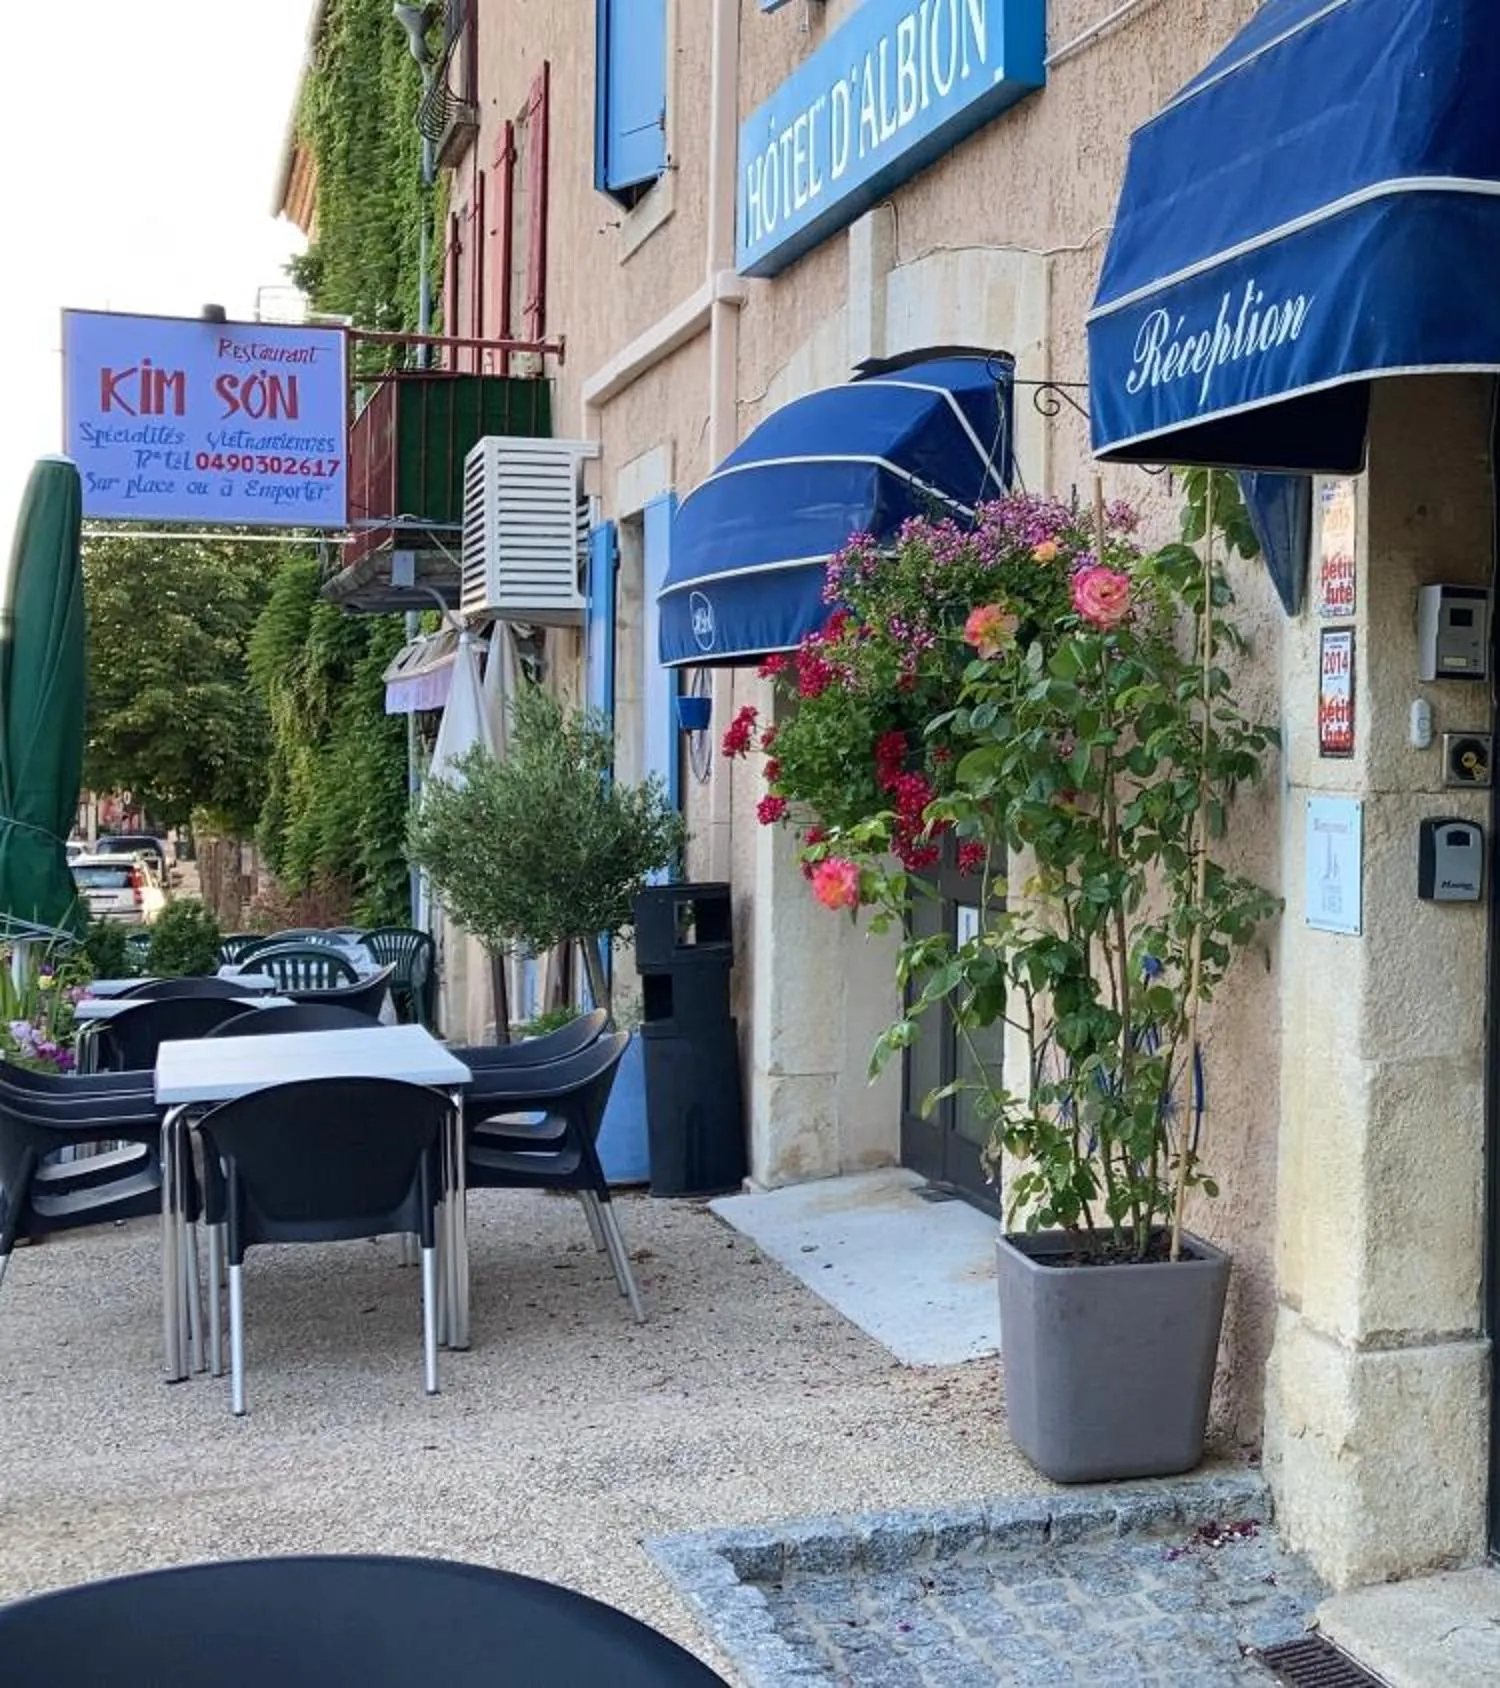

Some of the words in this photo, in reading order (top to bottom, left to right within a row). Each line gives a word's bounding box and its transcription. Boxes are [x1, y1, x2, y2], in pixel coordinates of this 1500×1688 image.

[831, 0, 987, 180] D'ALBION
[218, 336, 328, 364] Restaurant
[1126, 279, 1315, 406] Réception
[195, 452, 341, 478] 0490302617
[85, 471, 120, 494] Sur
[122, 473, 175, 499] place
[186, 480, 209, 495] ou
[220, 477, 234, 497] à
[244, 479, 334, 505] Emporter
[1323, 651, 1349, 674] 2014
